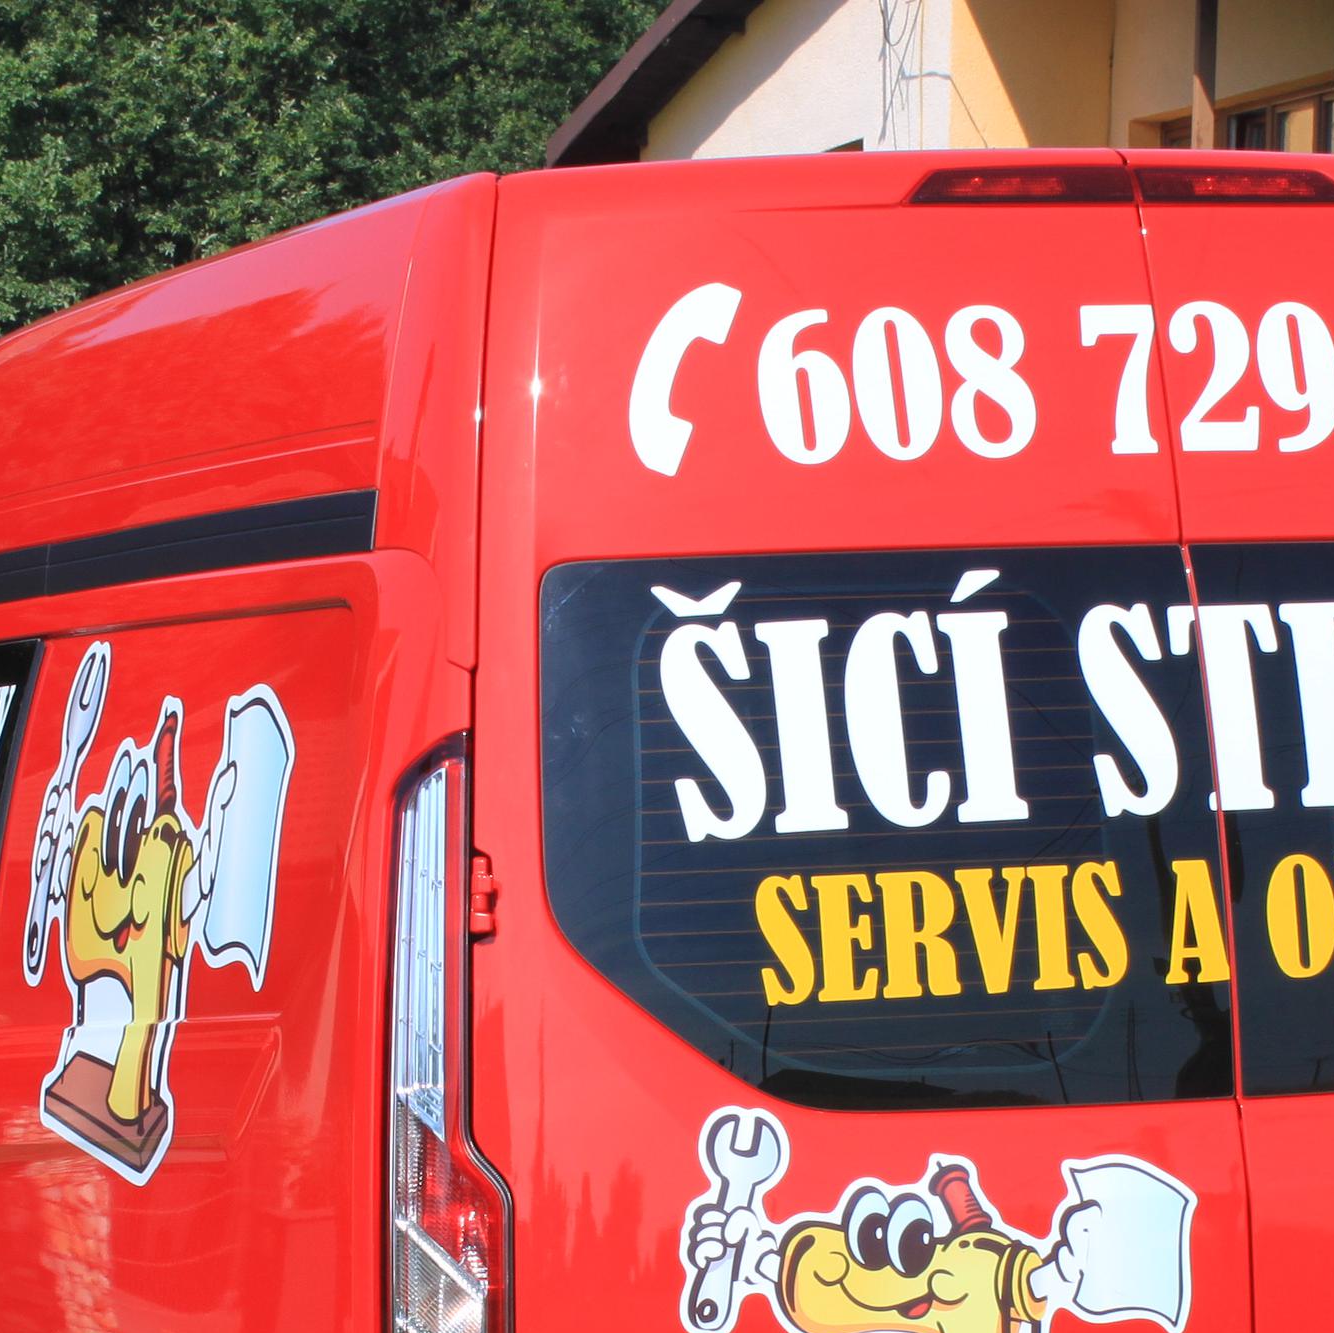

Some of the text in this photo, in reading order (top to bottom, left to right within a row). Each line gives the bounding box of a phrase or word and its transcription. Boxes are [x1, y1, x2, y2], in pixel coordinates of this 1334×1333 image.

[756, 304, 1038, 466] 608
[650, 568, 1030, 844] ŠICÍ
[754, 858, 1129, 1009] SERVIS
[1165, 858, 1231, 986] A
